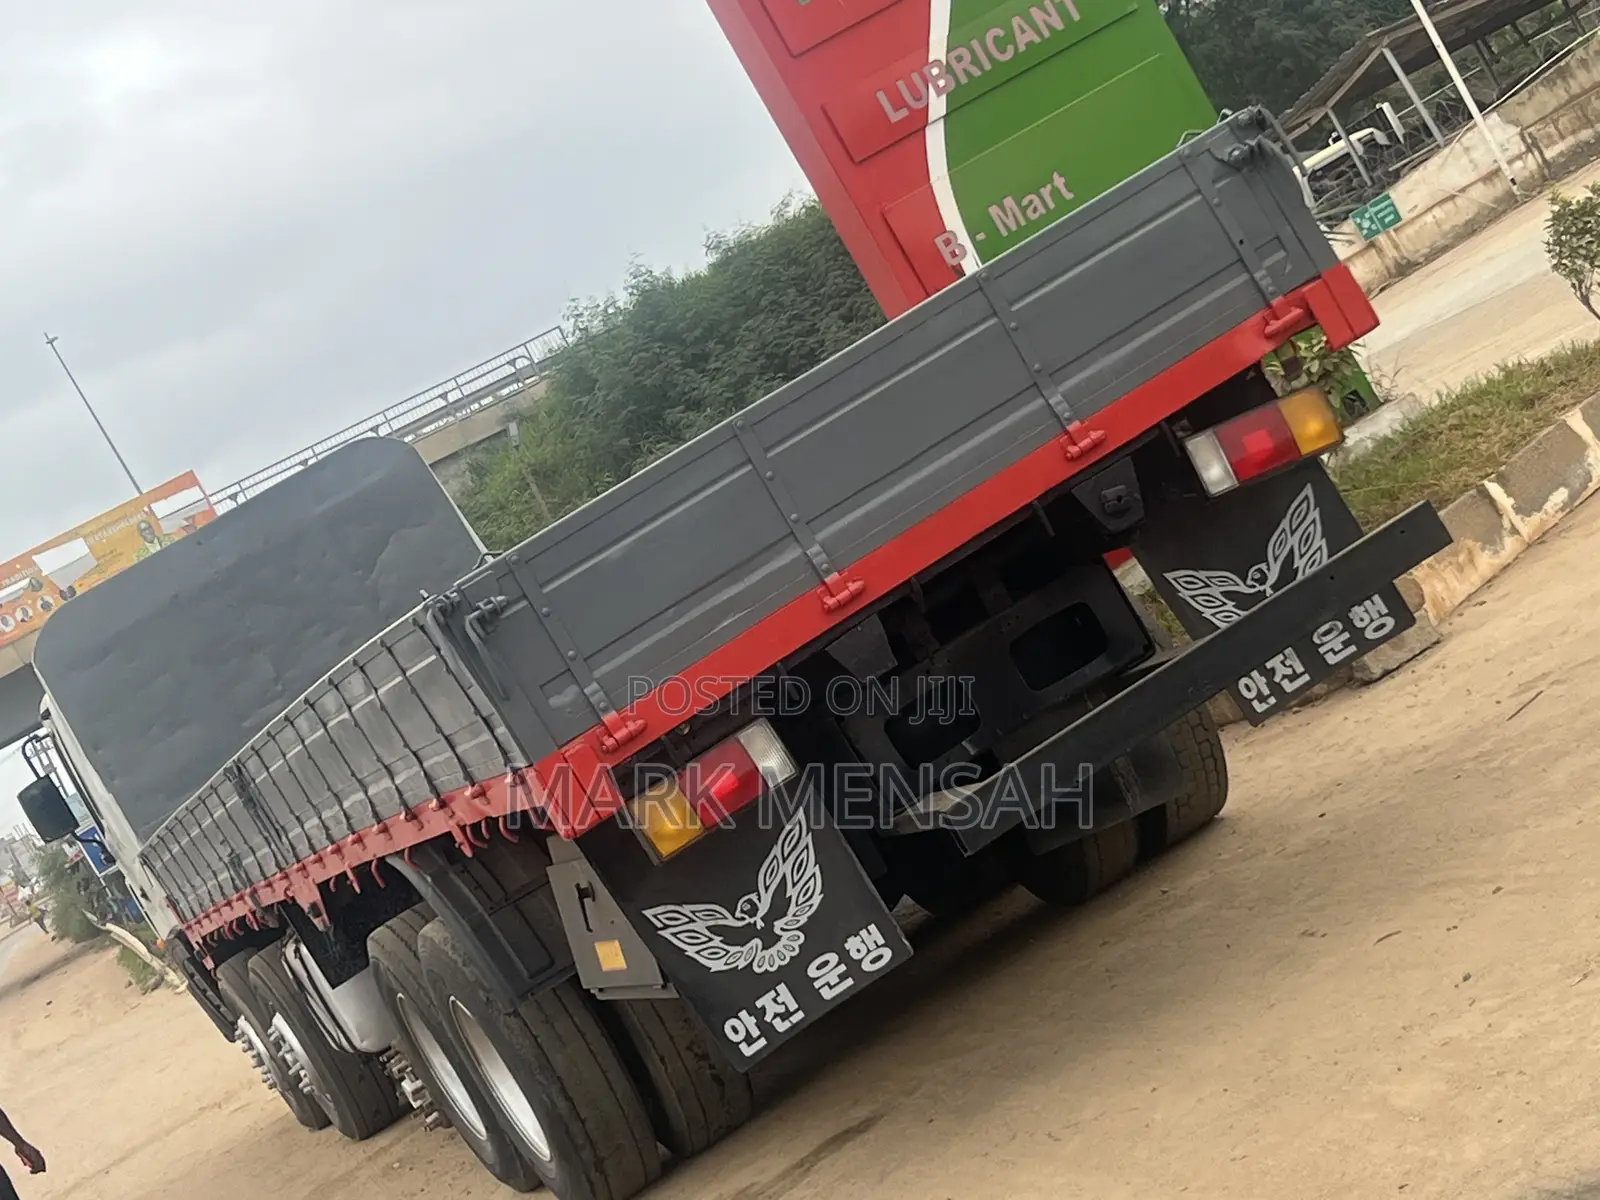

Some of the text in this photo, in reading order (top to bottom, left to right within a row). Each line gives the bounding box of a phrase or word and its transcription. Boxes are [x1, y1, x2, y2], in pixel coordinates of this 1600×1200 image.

[875, 0, 1080, 123] LUBRICANT
[934, 230, 967, 266] B
[988, 171, 1074, 237] Mart
[1237, 593, 1396, 713] 안전 운행
[723, 923, 893, 1057] 안전 운행
